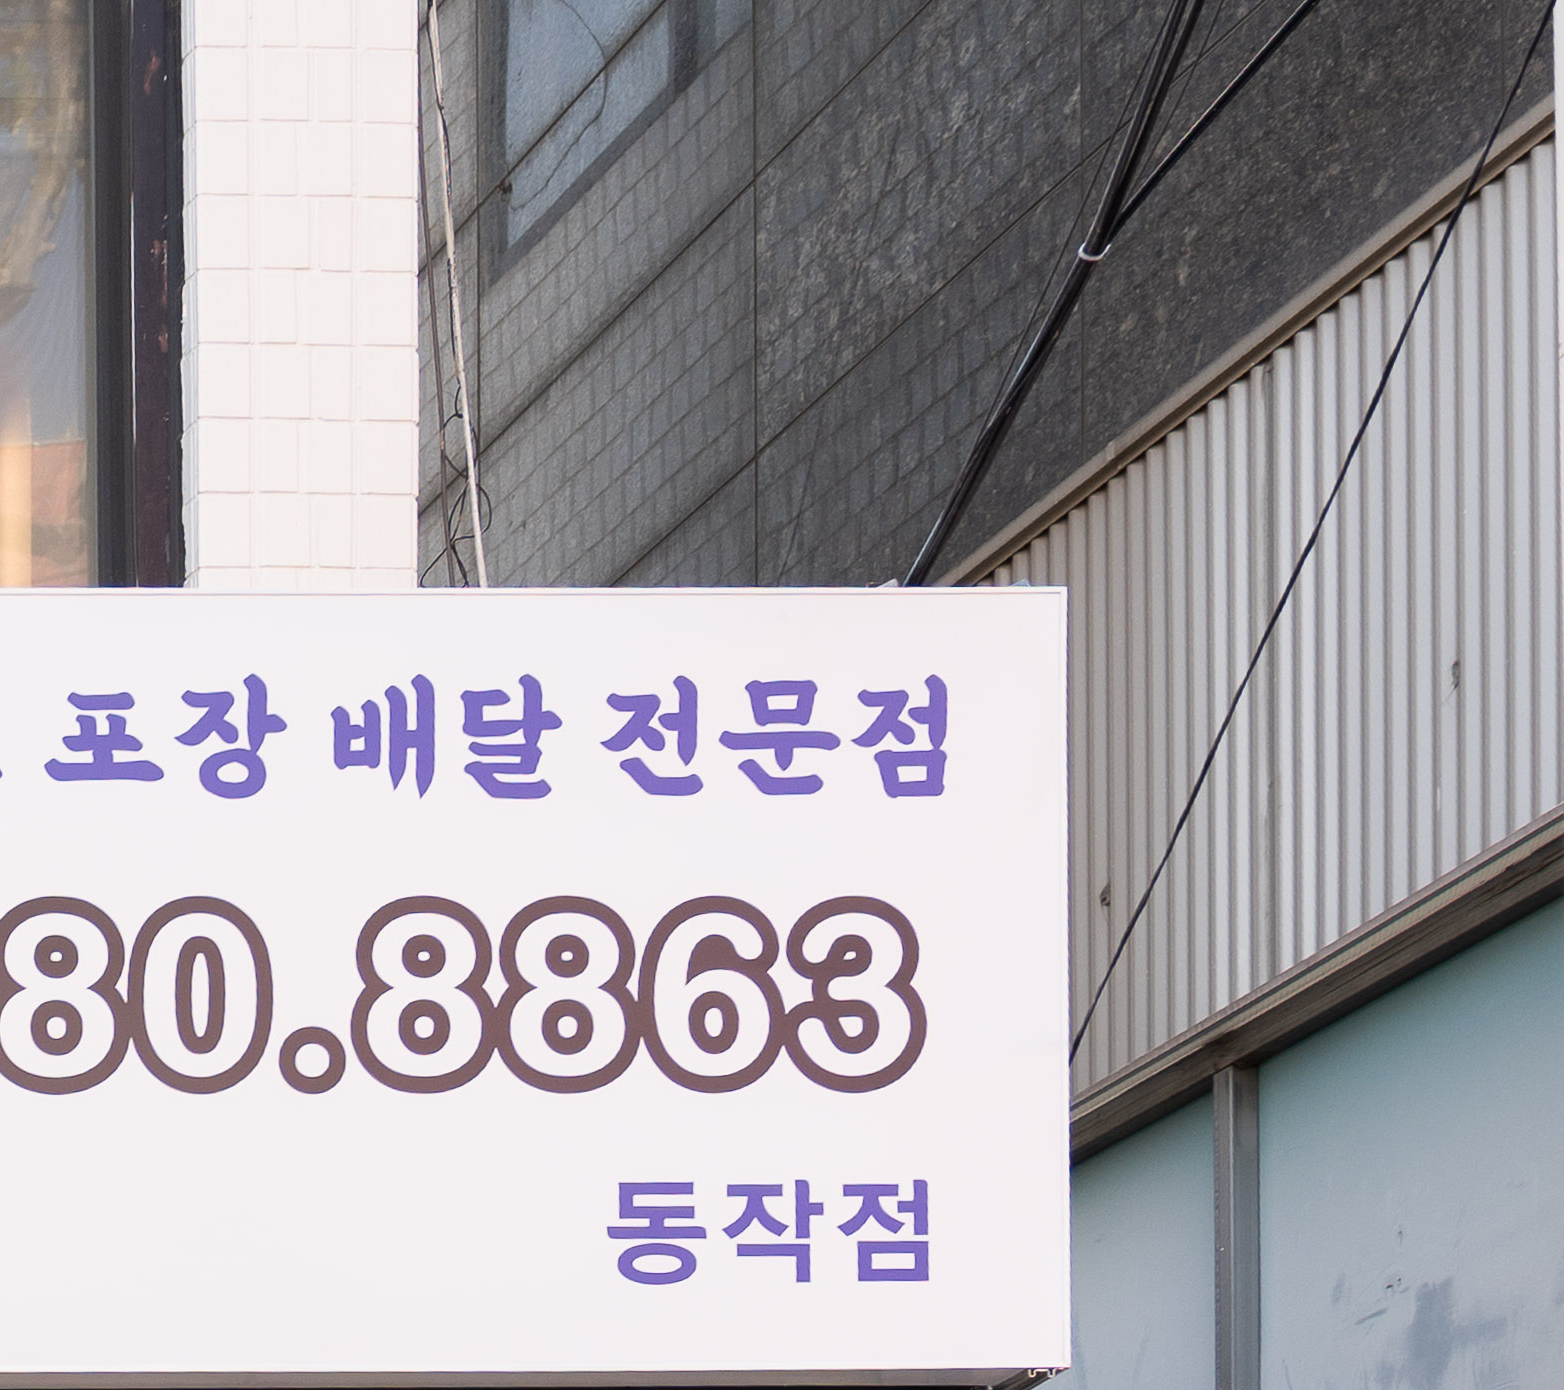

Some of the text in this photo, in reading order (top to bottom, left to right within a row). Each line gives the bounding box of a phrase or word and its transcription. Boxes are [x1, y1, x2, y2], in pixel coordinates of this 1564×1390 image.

[43, 673, 288, 800] 포장
[330, 673, 563, 800] 배달
[601, 674, 948, 799] 전문점
[606, 1179, 930, 1286] 동작점
